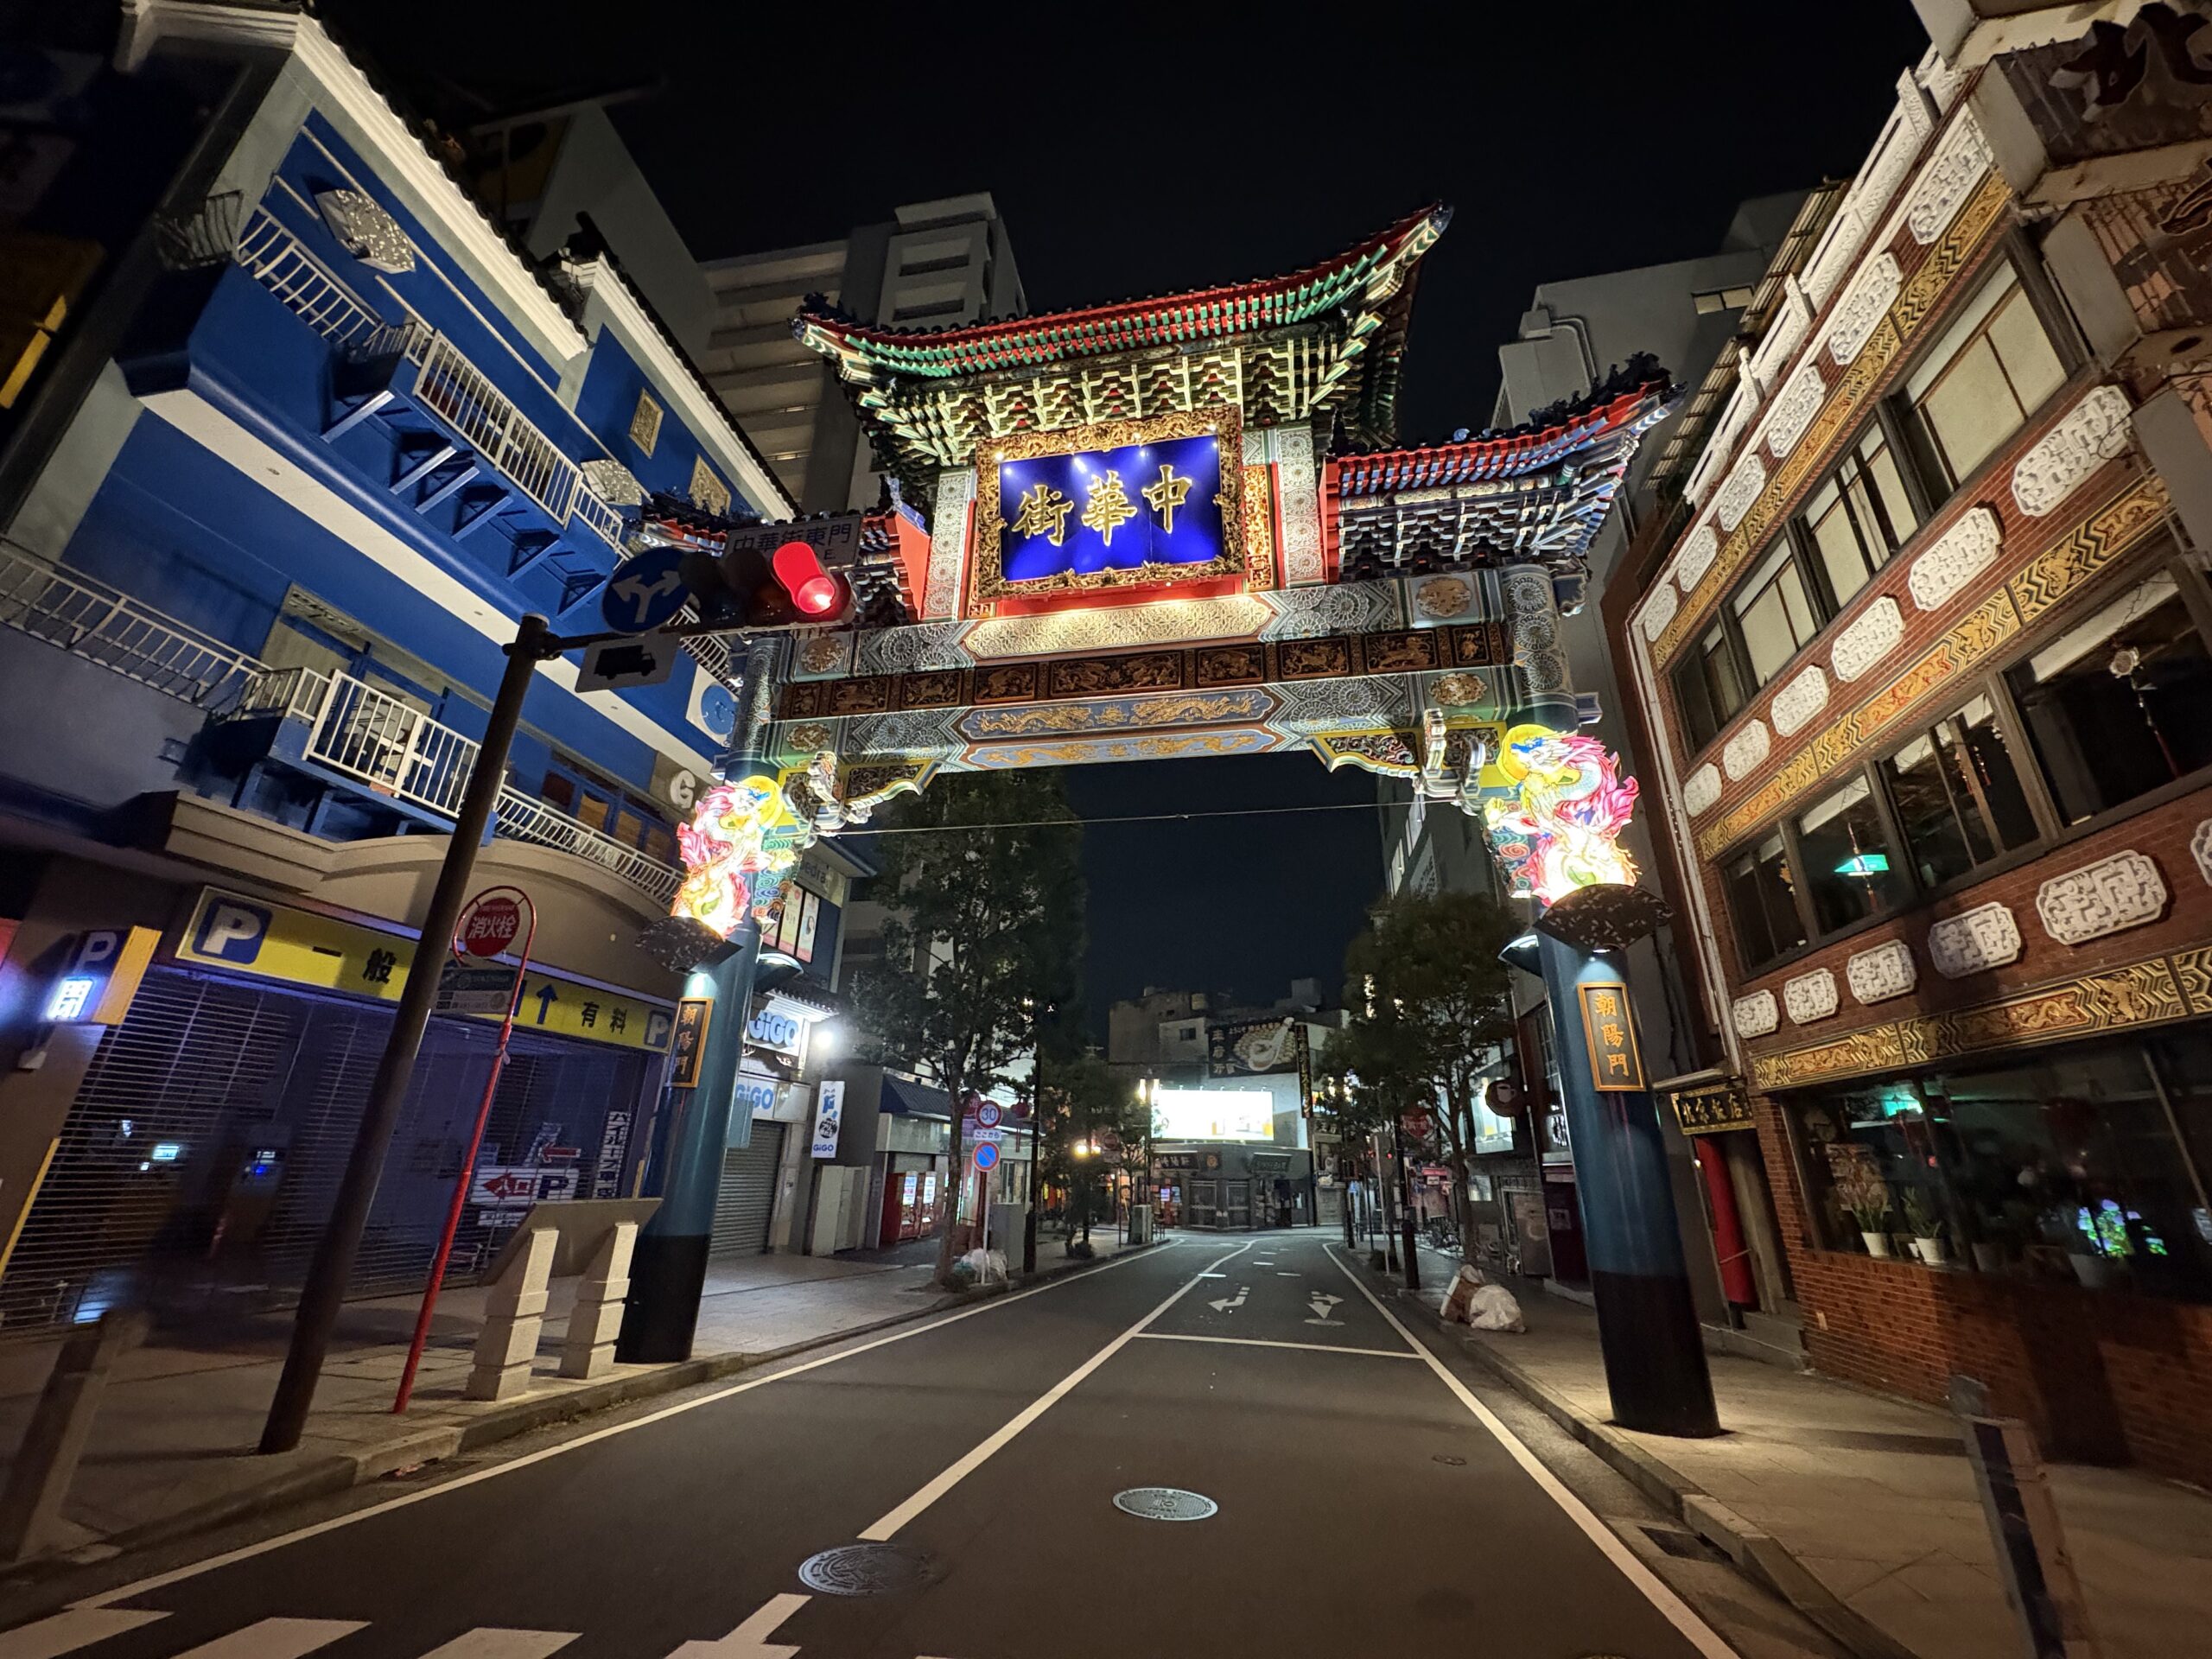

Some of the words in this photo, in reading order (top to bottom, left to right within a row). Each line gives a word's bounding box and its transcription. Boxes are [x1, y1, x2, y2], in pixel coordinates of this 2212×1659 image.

[1011, 464, 1192, 548] 中華街
[734, 523, 852, 551] 中華街東門
[201, 906, 260, 955] P
[467, 913, 518, 940] 消火栓
[73, 931, 118, 975] P
[312, 945, 397, 985] 一般
[581, 1001, 628, 1034] 有料
[647, 1017, 670, 1046] P
[748, 1009, 799, 1047] GiGO
[675, 1006, 698, 1076] 朝陽門
[1594, 993, 1630, 1077] 朝陽門
[982, 1108, 997, 1122] 30
[813, 1142, 834, 1152] GiGO
[975, 1130, 1001, 1139] ここから
[495, 1177, 532, 1195] 入口
[537, 1175, 569, 1199] P
